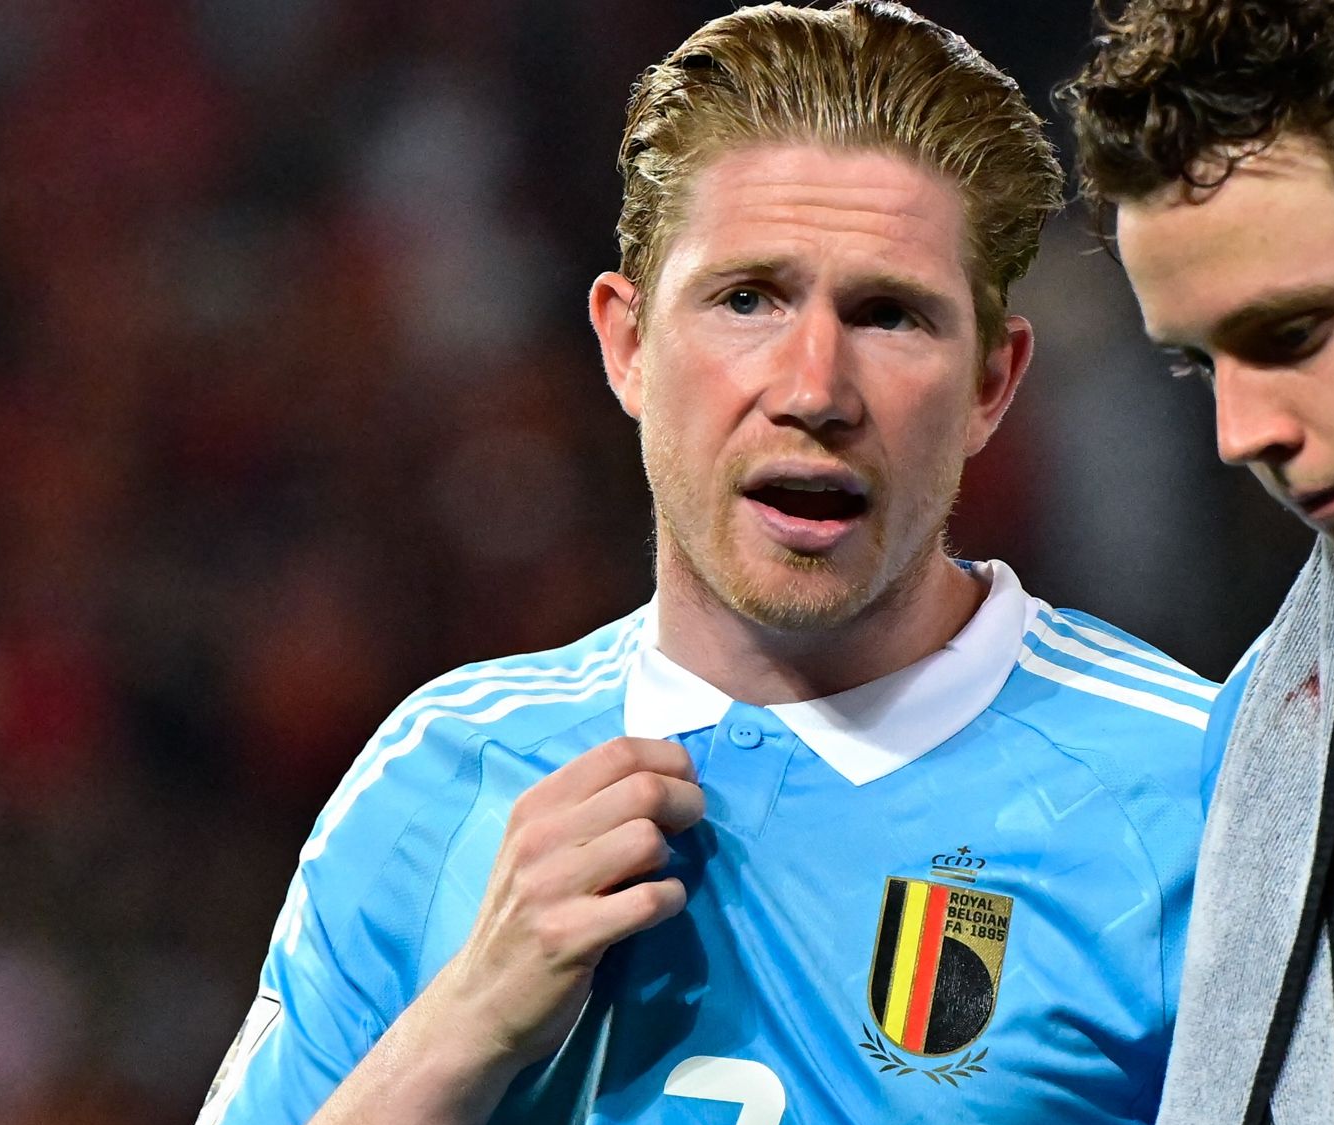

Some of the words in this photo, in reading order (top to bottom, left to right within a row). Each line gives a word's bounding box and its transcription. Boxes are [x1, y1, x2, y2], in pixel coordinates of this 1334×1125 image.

[949, 892, 994, 911] ROYAL
[947, 906, 1007, 928] BELGIAN
[944, 920, 962, 935] FA
[970, 925, 1006, 942] 1895
